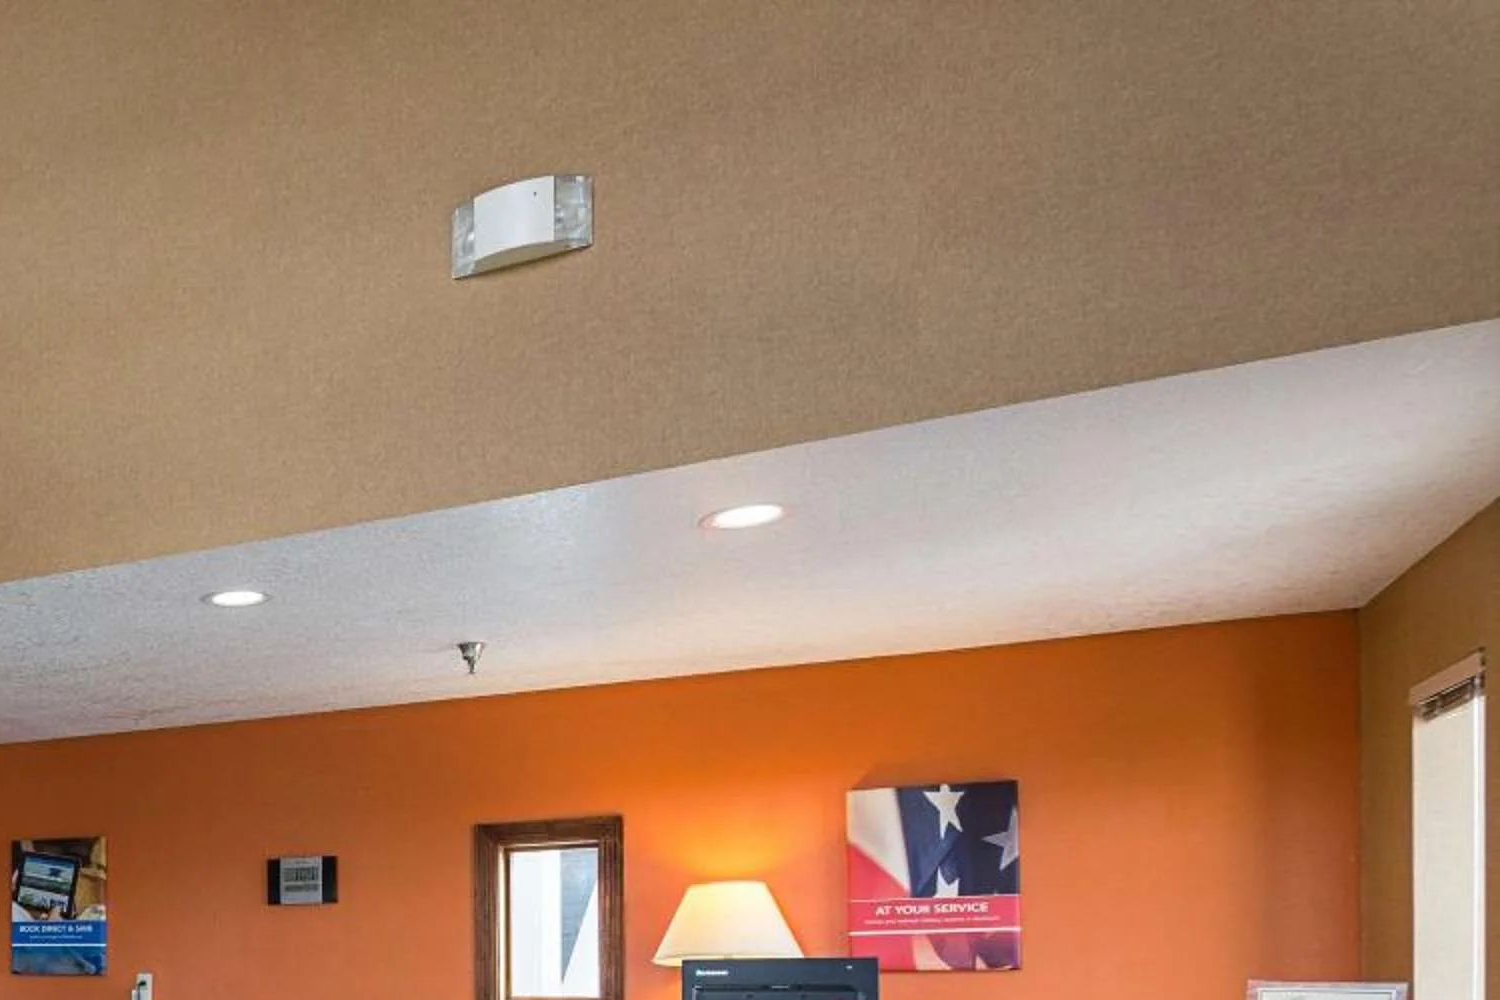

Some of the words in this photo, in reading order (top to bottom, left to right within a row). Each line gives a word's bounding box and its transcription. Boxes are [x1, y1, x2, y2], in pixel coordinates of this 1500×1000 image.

[875, 905, 891, 916] AT
[895, 904, 931, 915] YOUR
[933, 902, 989, 914] SERVICE
[19, 925, 40, 933] BOOK
